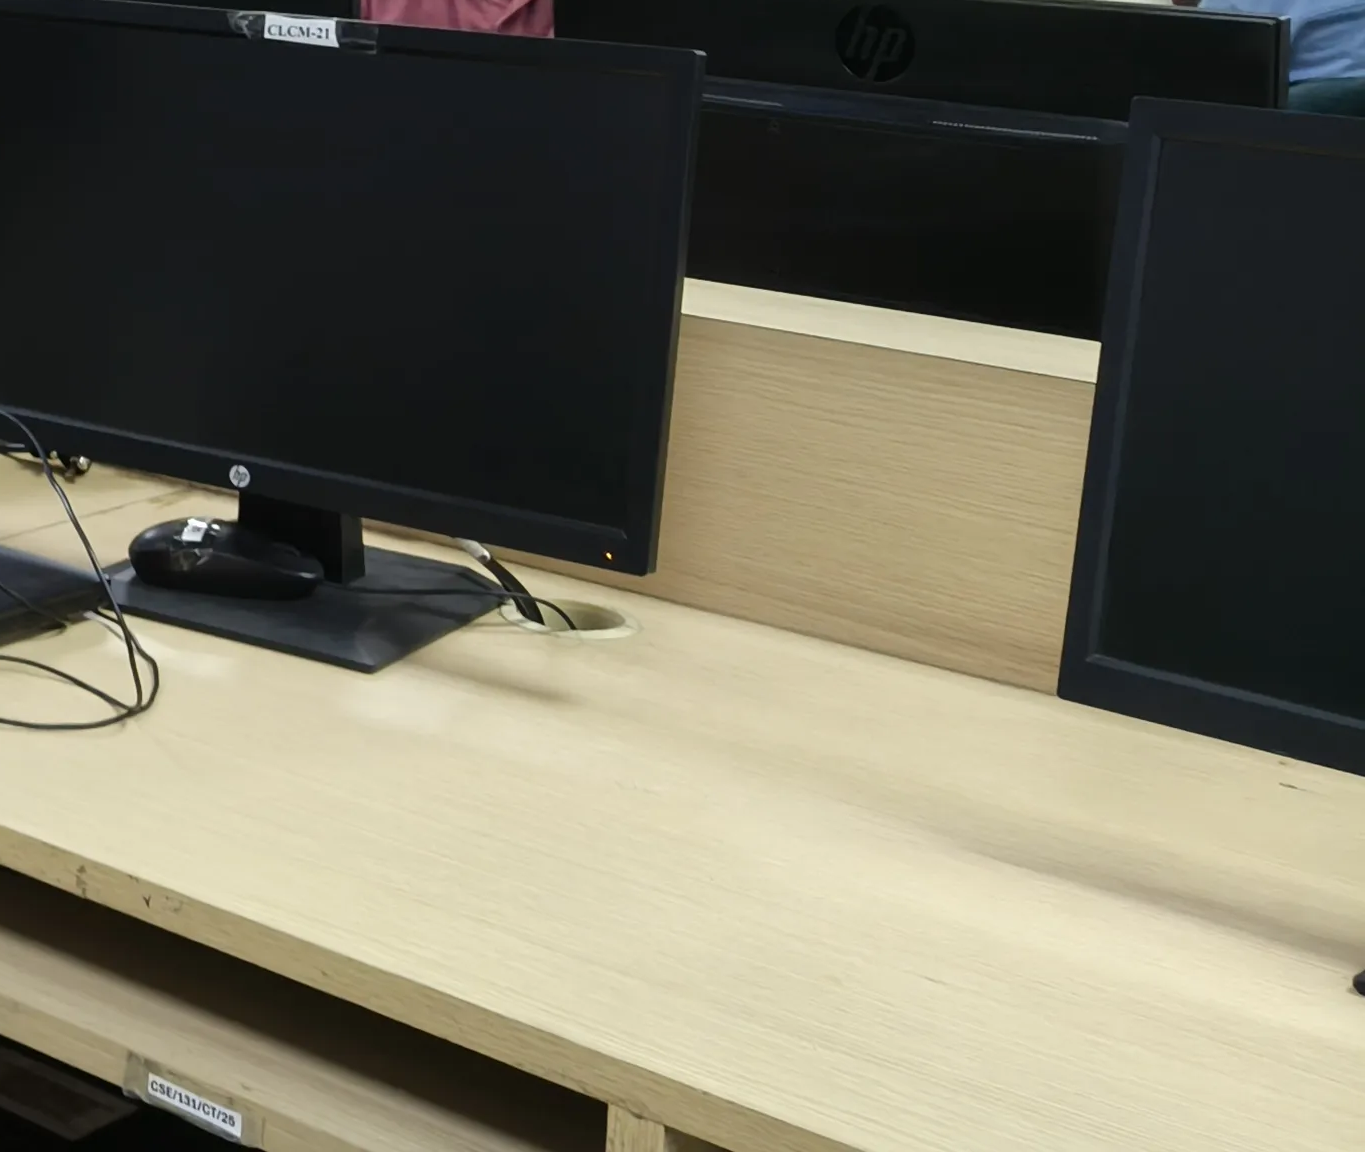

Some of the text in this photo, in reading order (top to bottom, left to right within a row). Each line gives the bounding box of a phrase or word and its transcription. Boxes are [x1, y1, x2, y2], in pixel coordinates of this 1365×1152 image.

[267, 23, 331, 40] CLCM-21
[840, 4, 911, 83] hp
[230, 465, 250, 488] hp
[150, 1080, 236, 1128] CSE/131/CT/25
